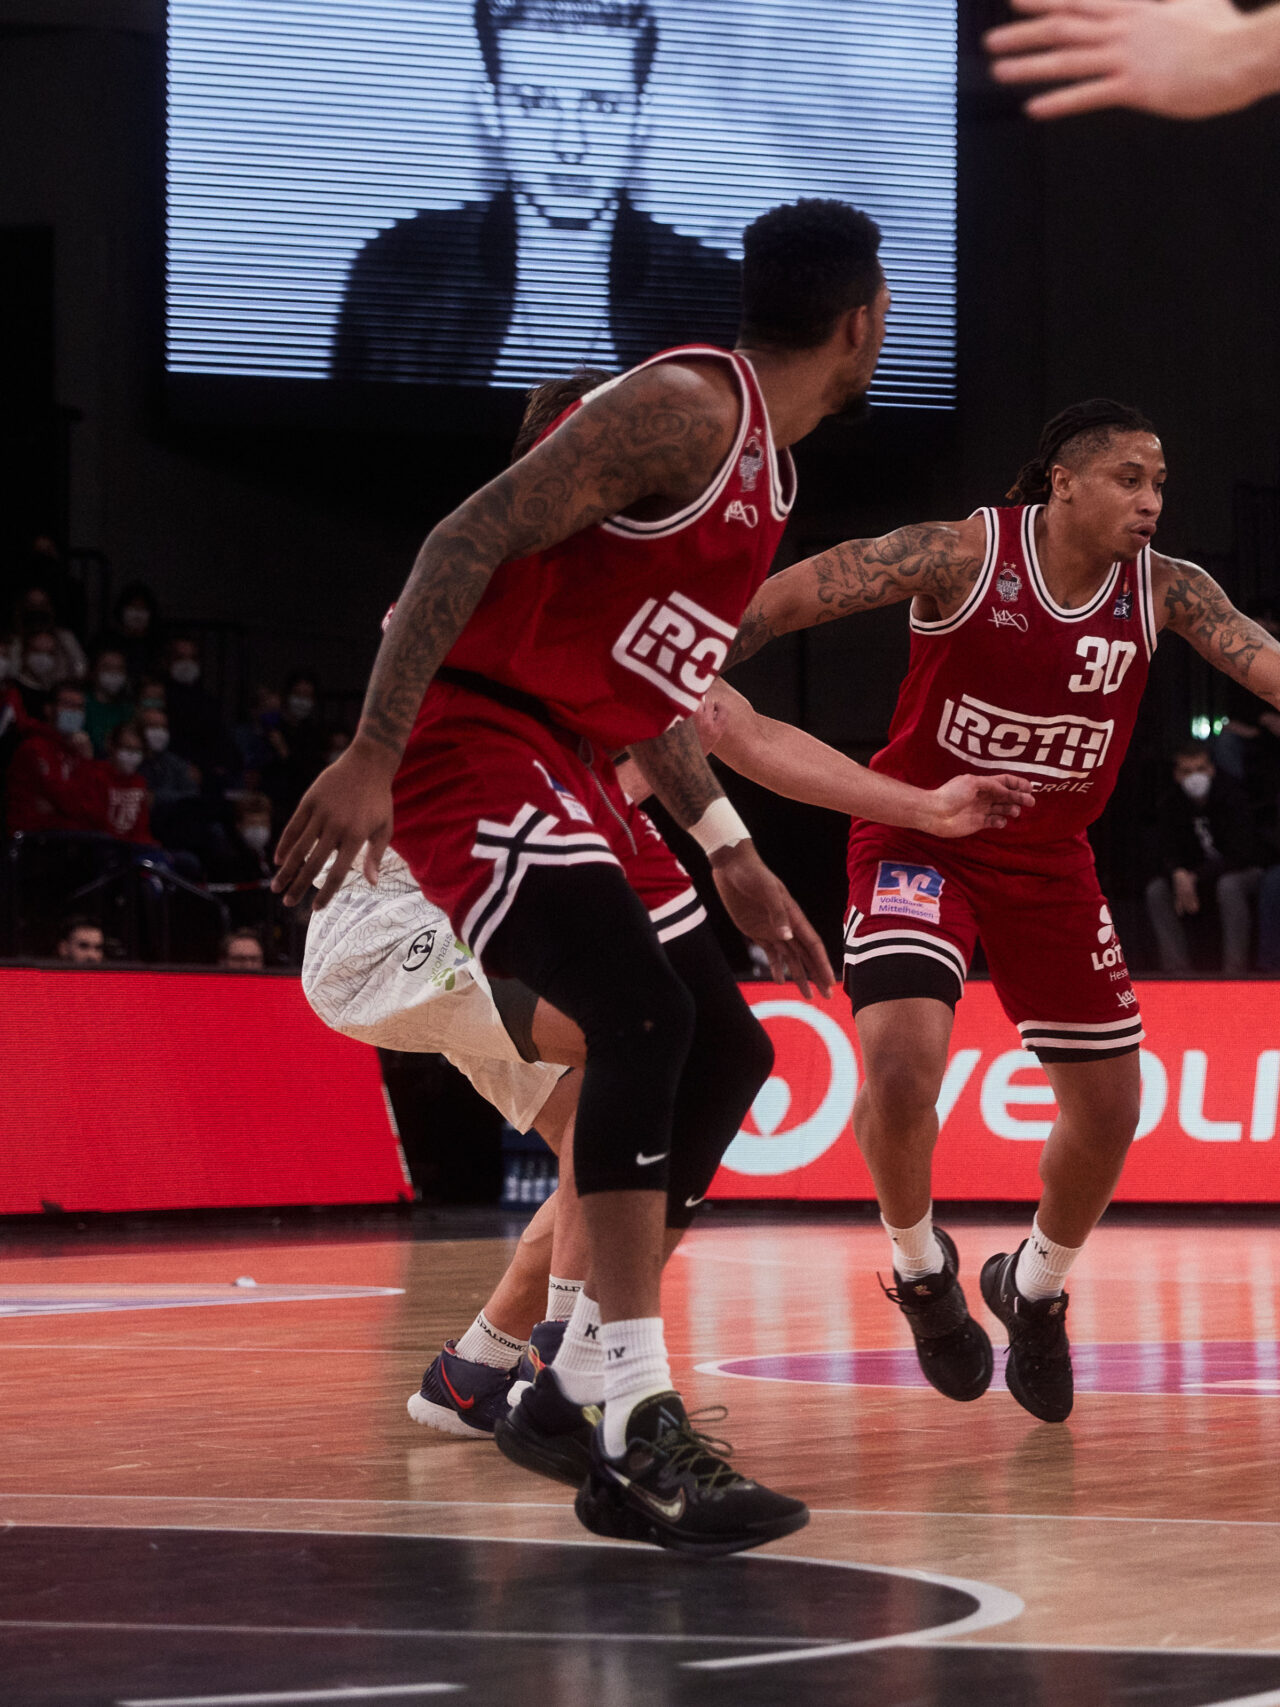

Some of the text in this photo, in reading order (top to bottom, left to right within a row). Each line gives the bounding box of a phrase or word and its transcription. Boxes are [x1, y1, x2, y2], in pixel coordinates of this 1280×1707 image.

[632, 604, 728, 694] RO
[1068, 635, 1137, 696] 30
[949, 705, 1105, 769] ROTH
[1030, 780, 1096, 794] ERGIE
[878, 904, 935, 919] Mittelhessen
[1091, 943, 1123, 971] LOT
